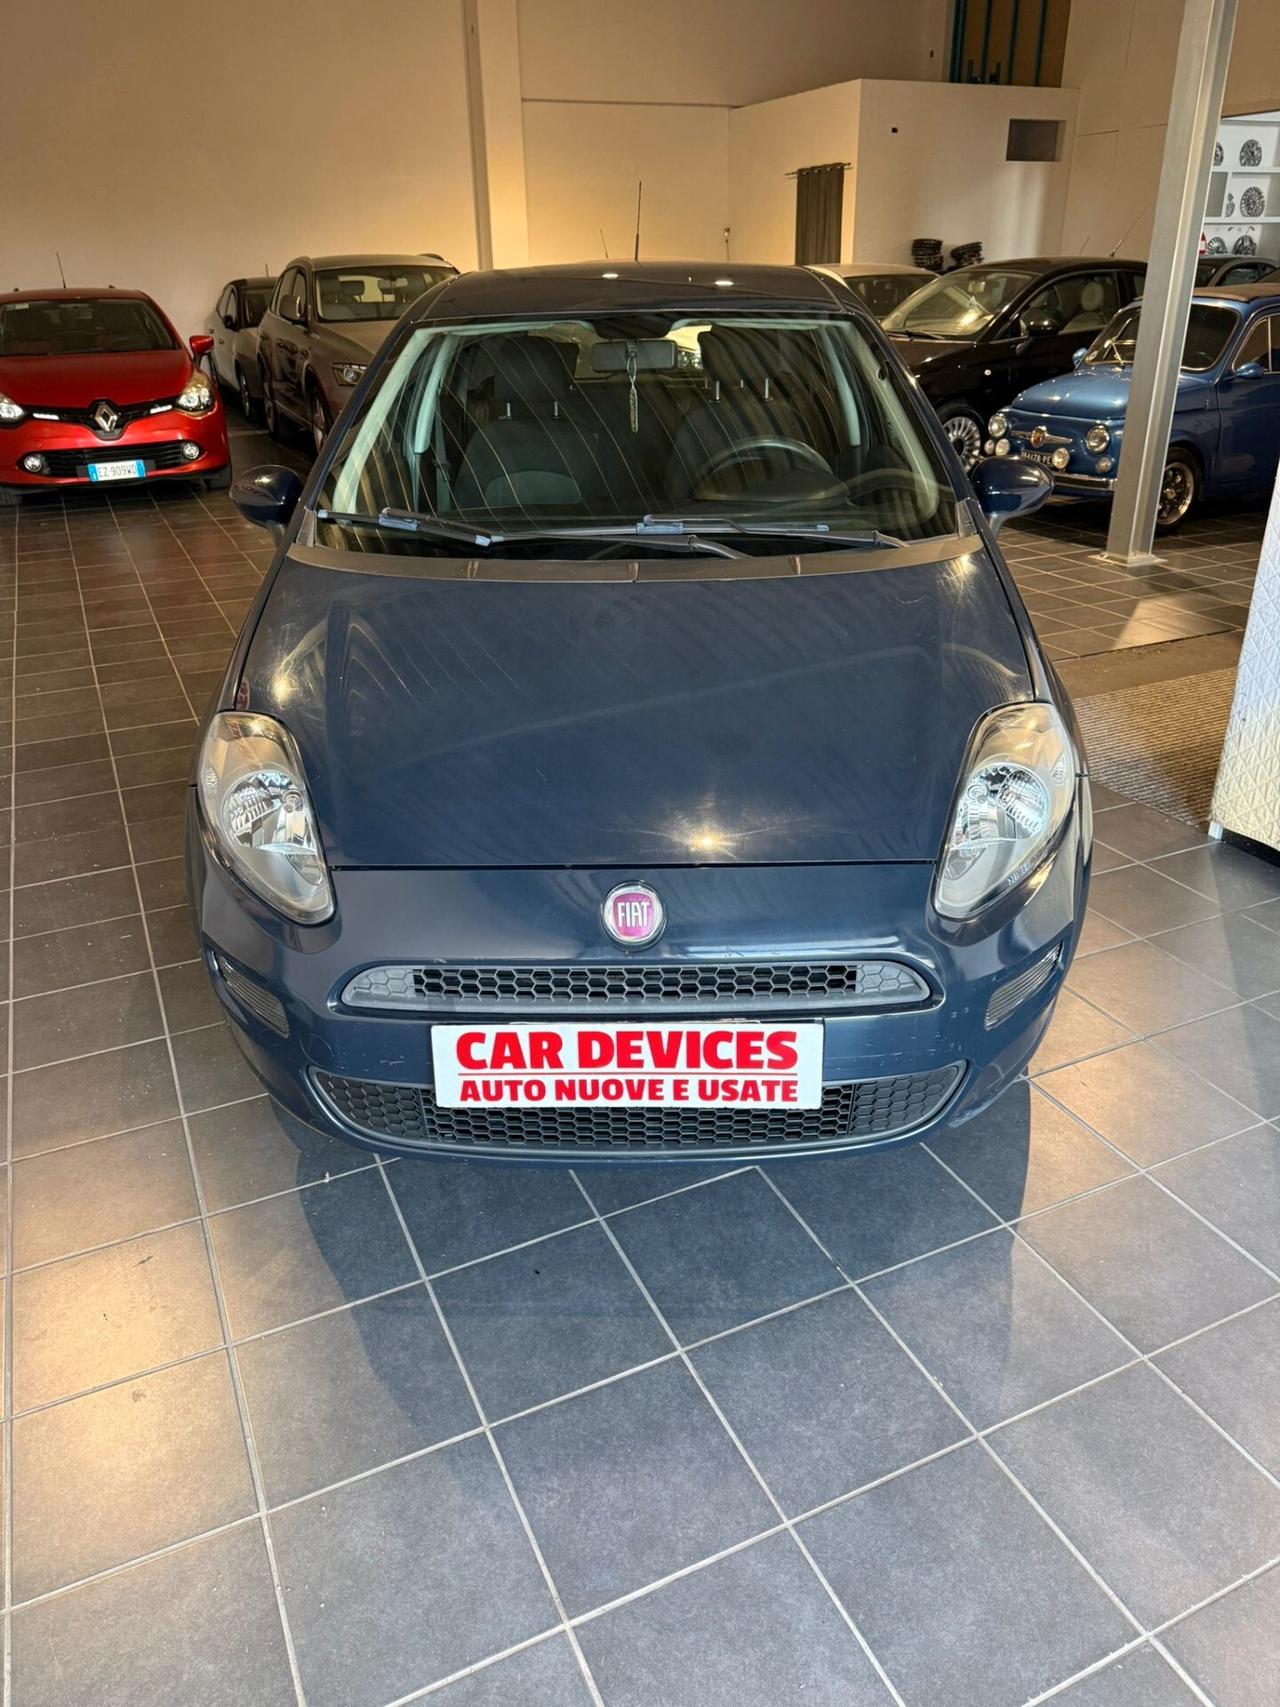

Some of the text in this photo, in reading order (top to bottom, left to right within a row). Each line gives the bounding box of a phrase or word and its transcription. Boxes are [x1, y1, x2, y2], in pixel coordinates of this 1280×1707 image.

[617, 901, 651, 928] FIAT
[456, 1030, 799, 1070] CAR DEVICES
[460, 1078, 798, 1102] AUTO NUOVE E USATE
